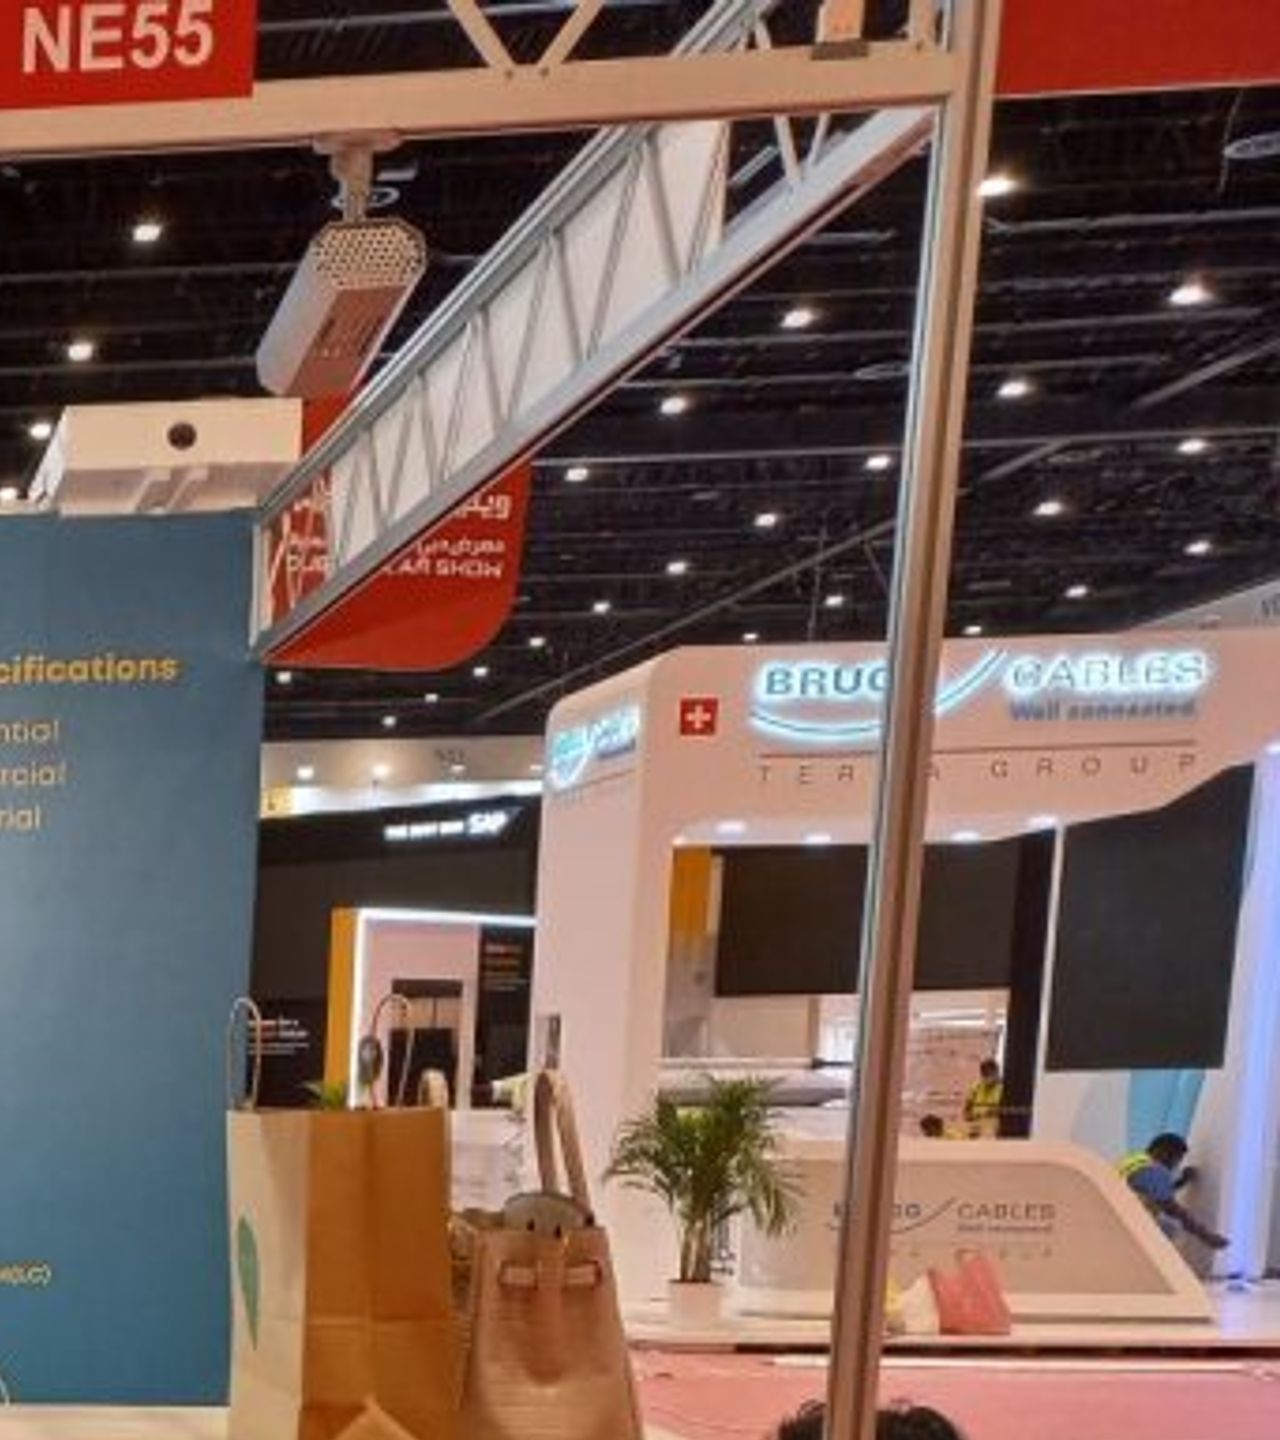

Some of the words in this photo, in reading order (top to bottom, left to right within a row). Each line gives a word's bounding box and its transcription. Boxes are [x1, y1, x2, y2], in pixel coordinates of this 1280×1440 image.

[22, 0, 214, 74] NE55
[764, 666, 890, 696] BRU
[1012, 653, 1205, 689] CABLES
